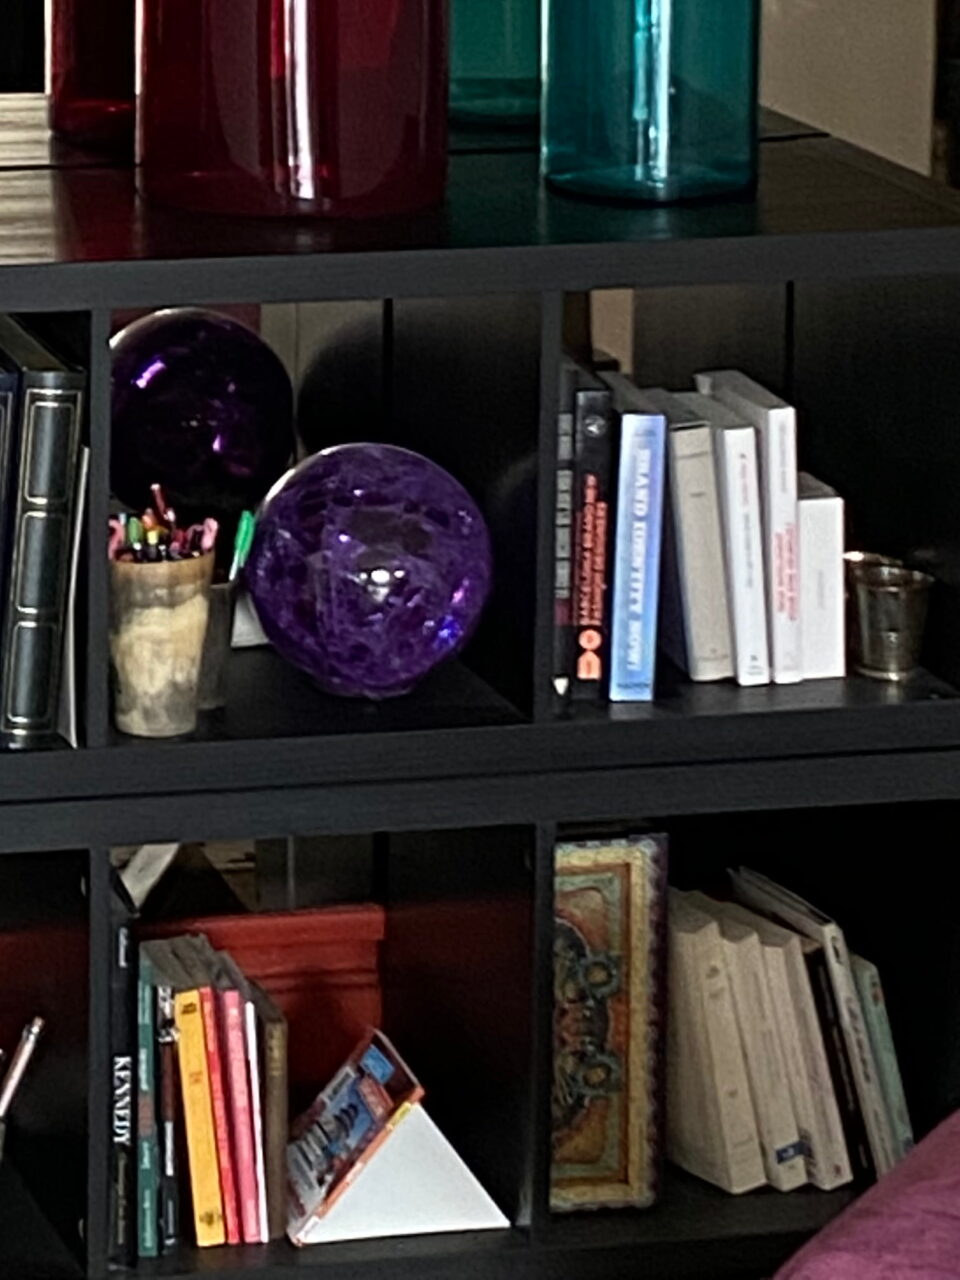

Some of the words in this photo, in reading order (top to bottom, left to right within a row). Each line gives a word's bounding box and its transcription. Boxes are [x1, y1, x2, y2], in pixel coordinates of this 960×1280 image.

[634, 447, 652, 516] BRAND
[629, 521, 649, 614] IDENTITY
[113, 1055, 132, 1145] KENNEDY
